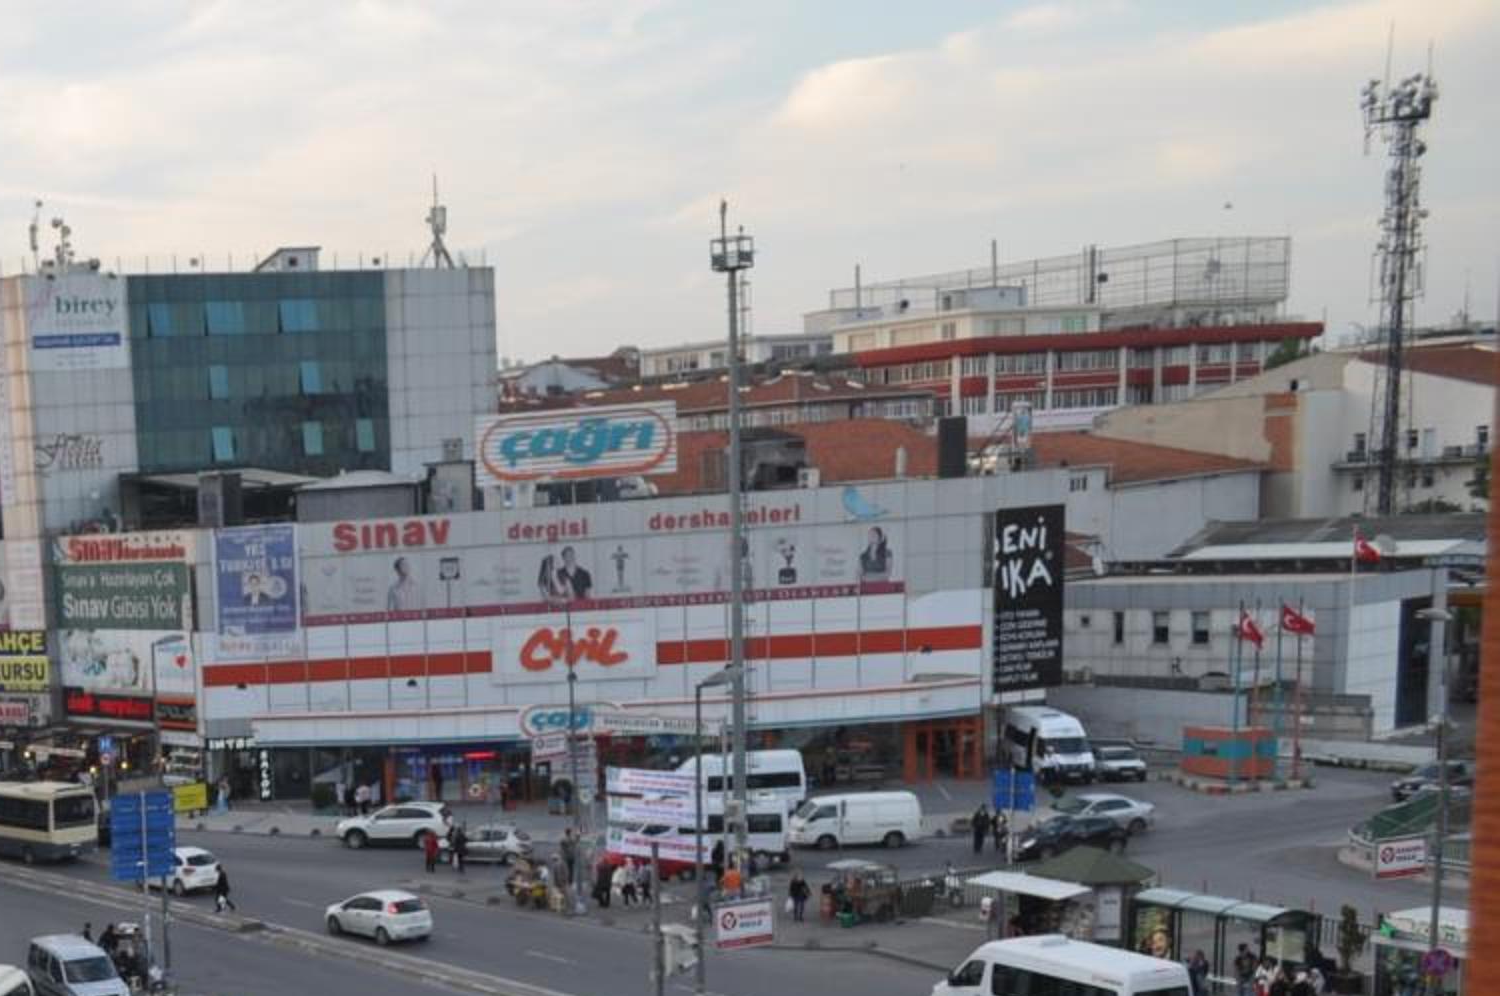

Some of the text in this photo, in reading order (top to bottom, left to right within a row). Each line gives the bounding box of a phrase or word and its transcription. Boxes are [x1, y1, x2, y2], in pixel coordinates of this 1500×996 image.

[55, 296, 117, 319] birey
[332, 504, 802, 552] sınav dergisi dershaeleri
[63, 593, 109, 619] Sınav
[150, 591, 178, 619] Yok
